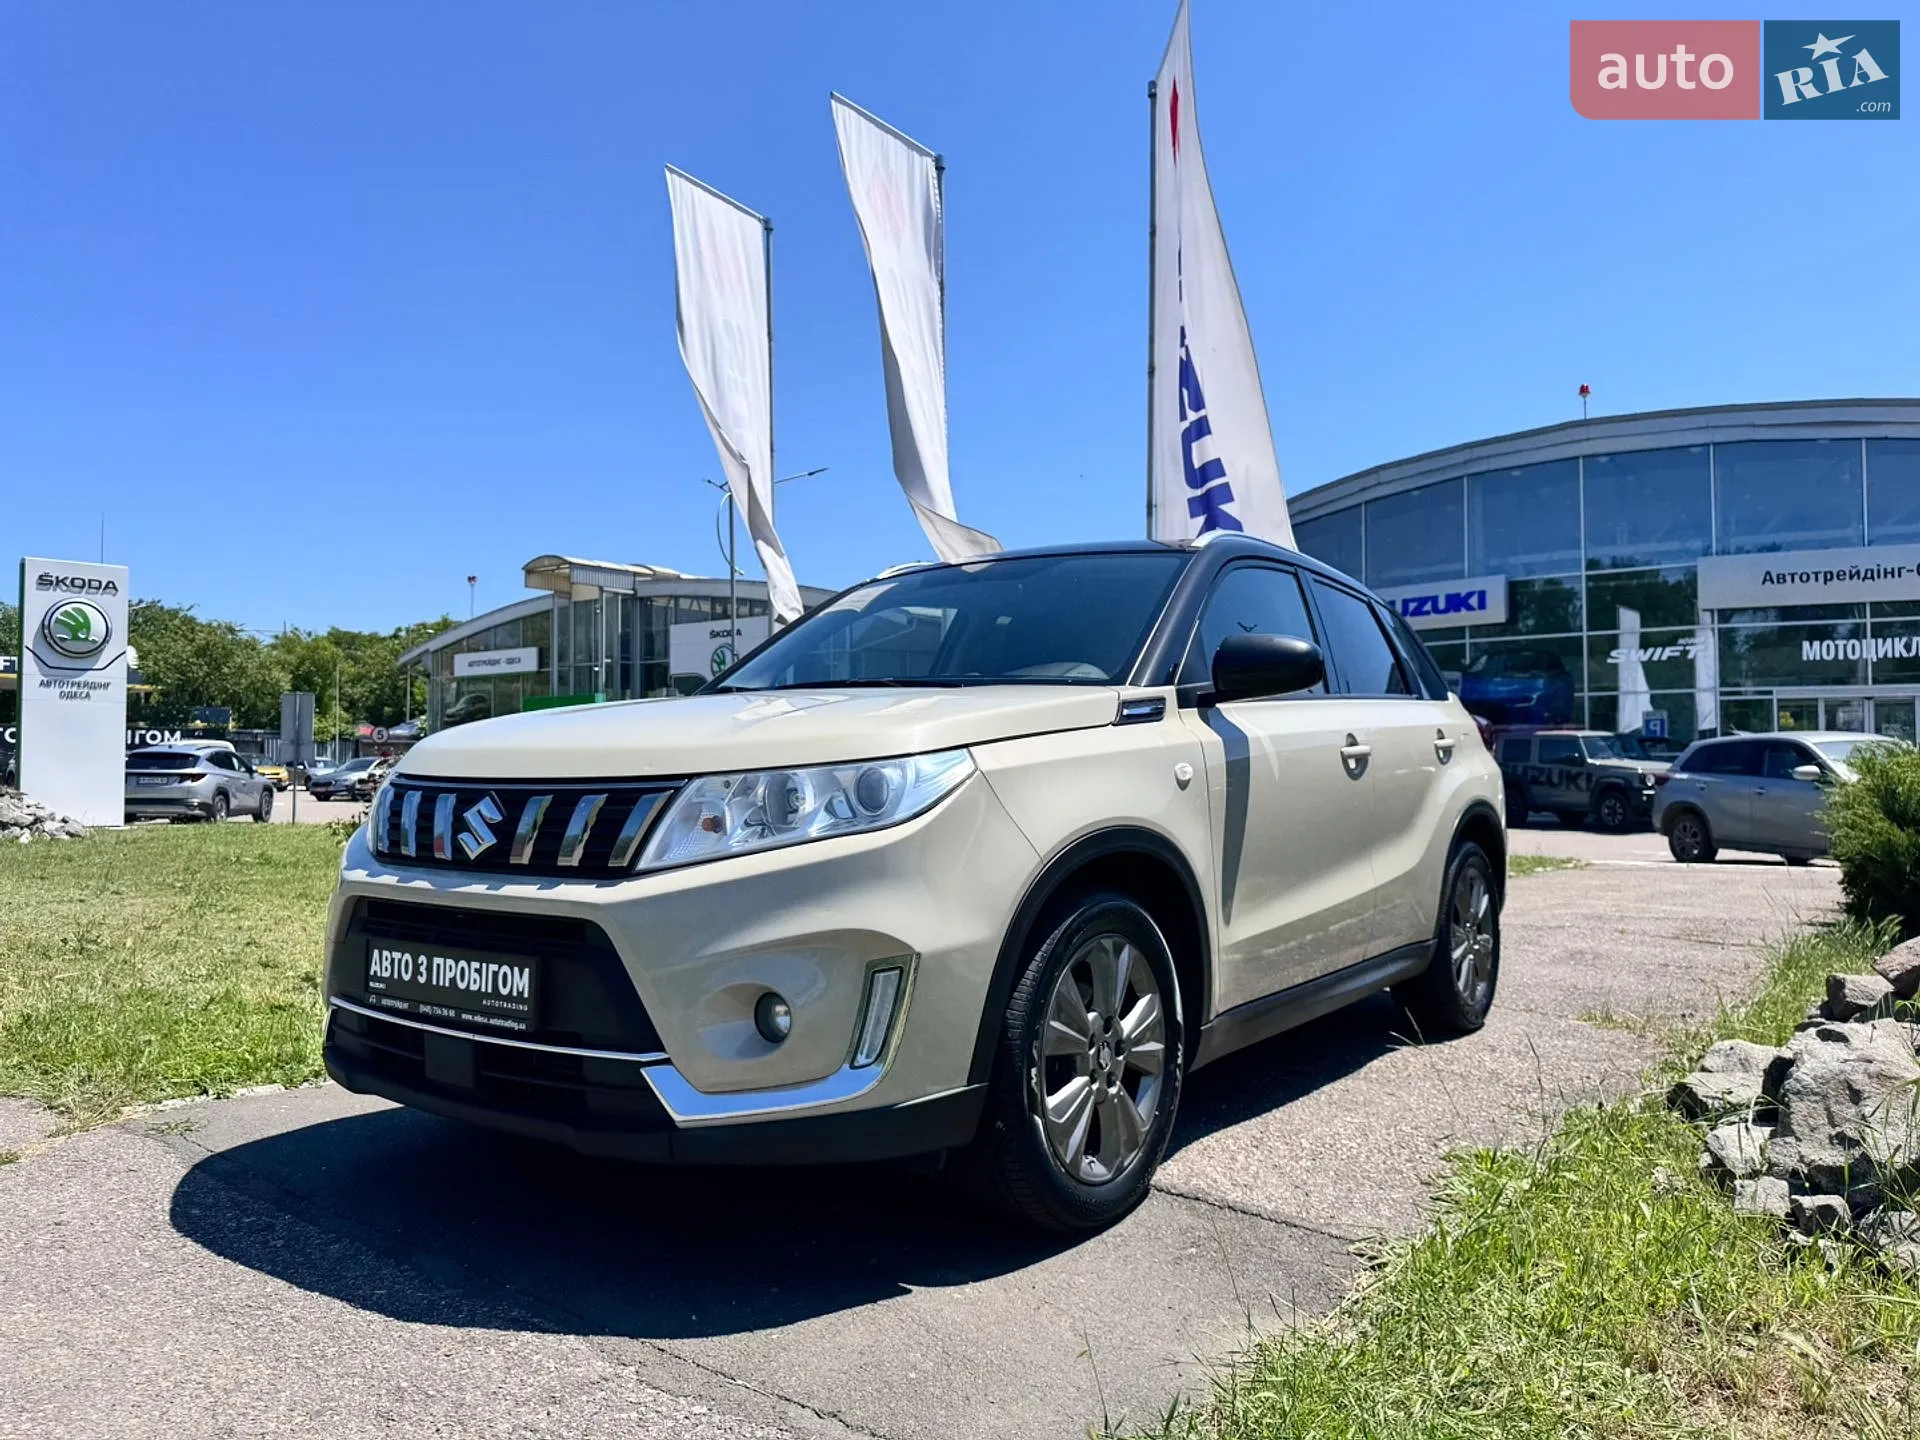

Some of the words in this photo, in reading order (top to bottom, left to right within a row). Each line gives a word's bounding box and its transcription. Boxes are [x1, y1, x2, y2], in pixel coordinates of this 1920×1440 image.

[37, 572, 119, 592] ŠKODA
[1387, 589, 1487, 618] UZUKI
[1606, 645, 1706, 664] SWIFT
[1802, 636, 1920, 662] МОТОЦИКЛ
[38, 678, 112, 691] АВТОТРЕЙДІНГ
[59, 690, 91, 701] ОДЕСА
[126, 729, 182, 745] ІГОМ
[376, 729, 385, 740] 5
[369, 949, 413, 982] АВТО
[432, 956, 530, 998] ПРОБІГОМ
[482, 999, 528, 1011] AUTOTRADING
